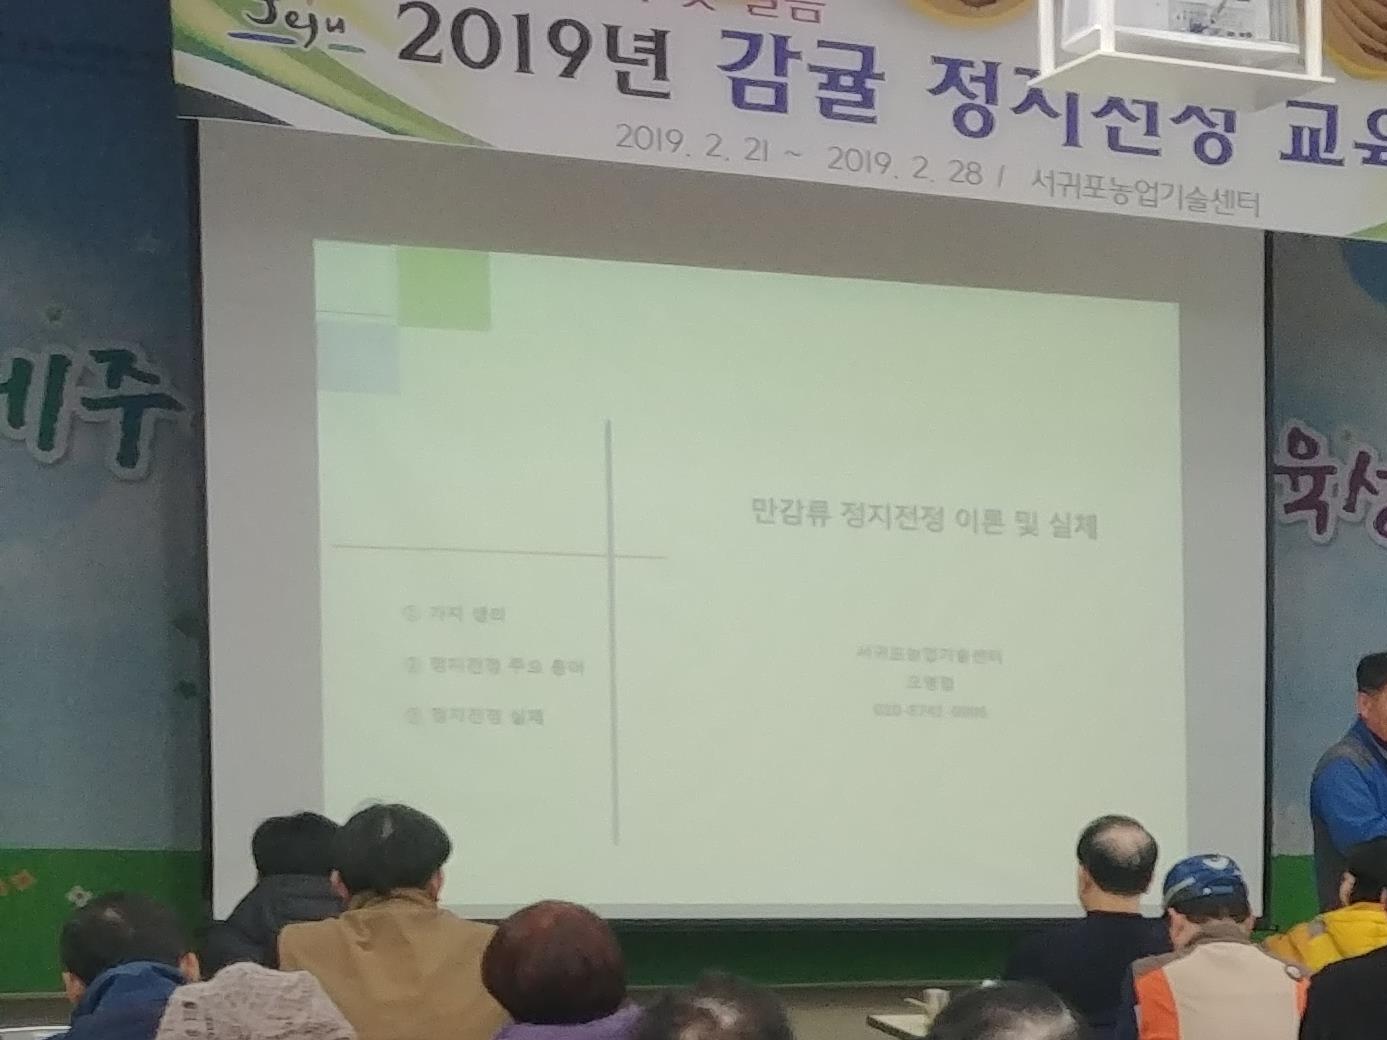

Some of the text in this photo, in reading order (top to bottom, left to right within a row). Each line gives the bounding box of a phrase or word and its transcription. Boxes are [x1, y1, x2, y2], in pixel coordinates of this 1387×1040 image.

[396, 0, 672, 101] 2019년
[716, 28, 886, 125] 감귤
[615, 122, 691, 158] 2019.
[705, 132, 730, 162] 2.
[743, 136, 769, 163] 21
[826, 145, 900, 180] 2019.
[911, 154, 936, 184] 2.
[949, 158, 984, 187] 28
[1031, 168, 1262, 218] 서귀포농업기술센터
[751, 496, 833, 529] 만감류
[840, 500, 947, 534] 정지전정
[955, 506, 1006, 537] 이론
[1014, 508, 1040, 538] 및
